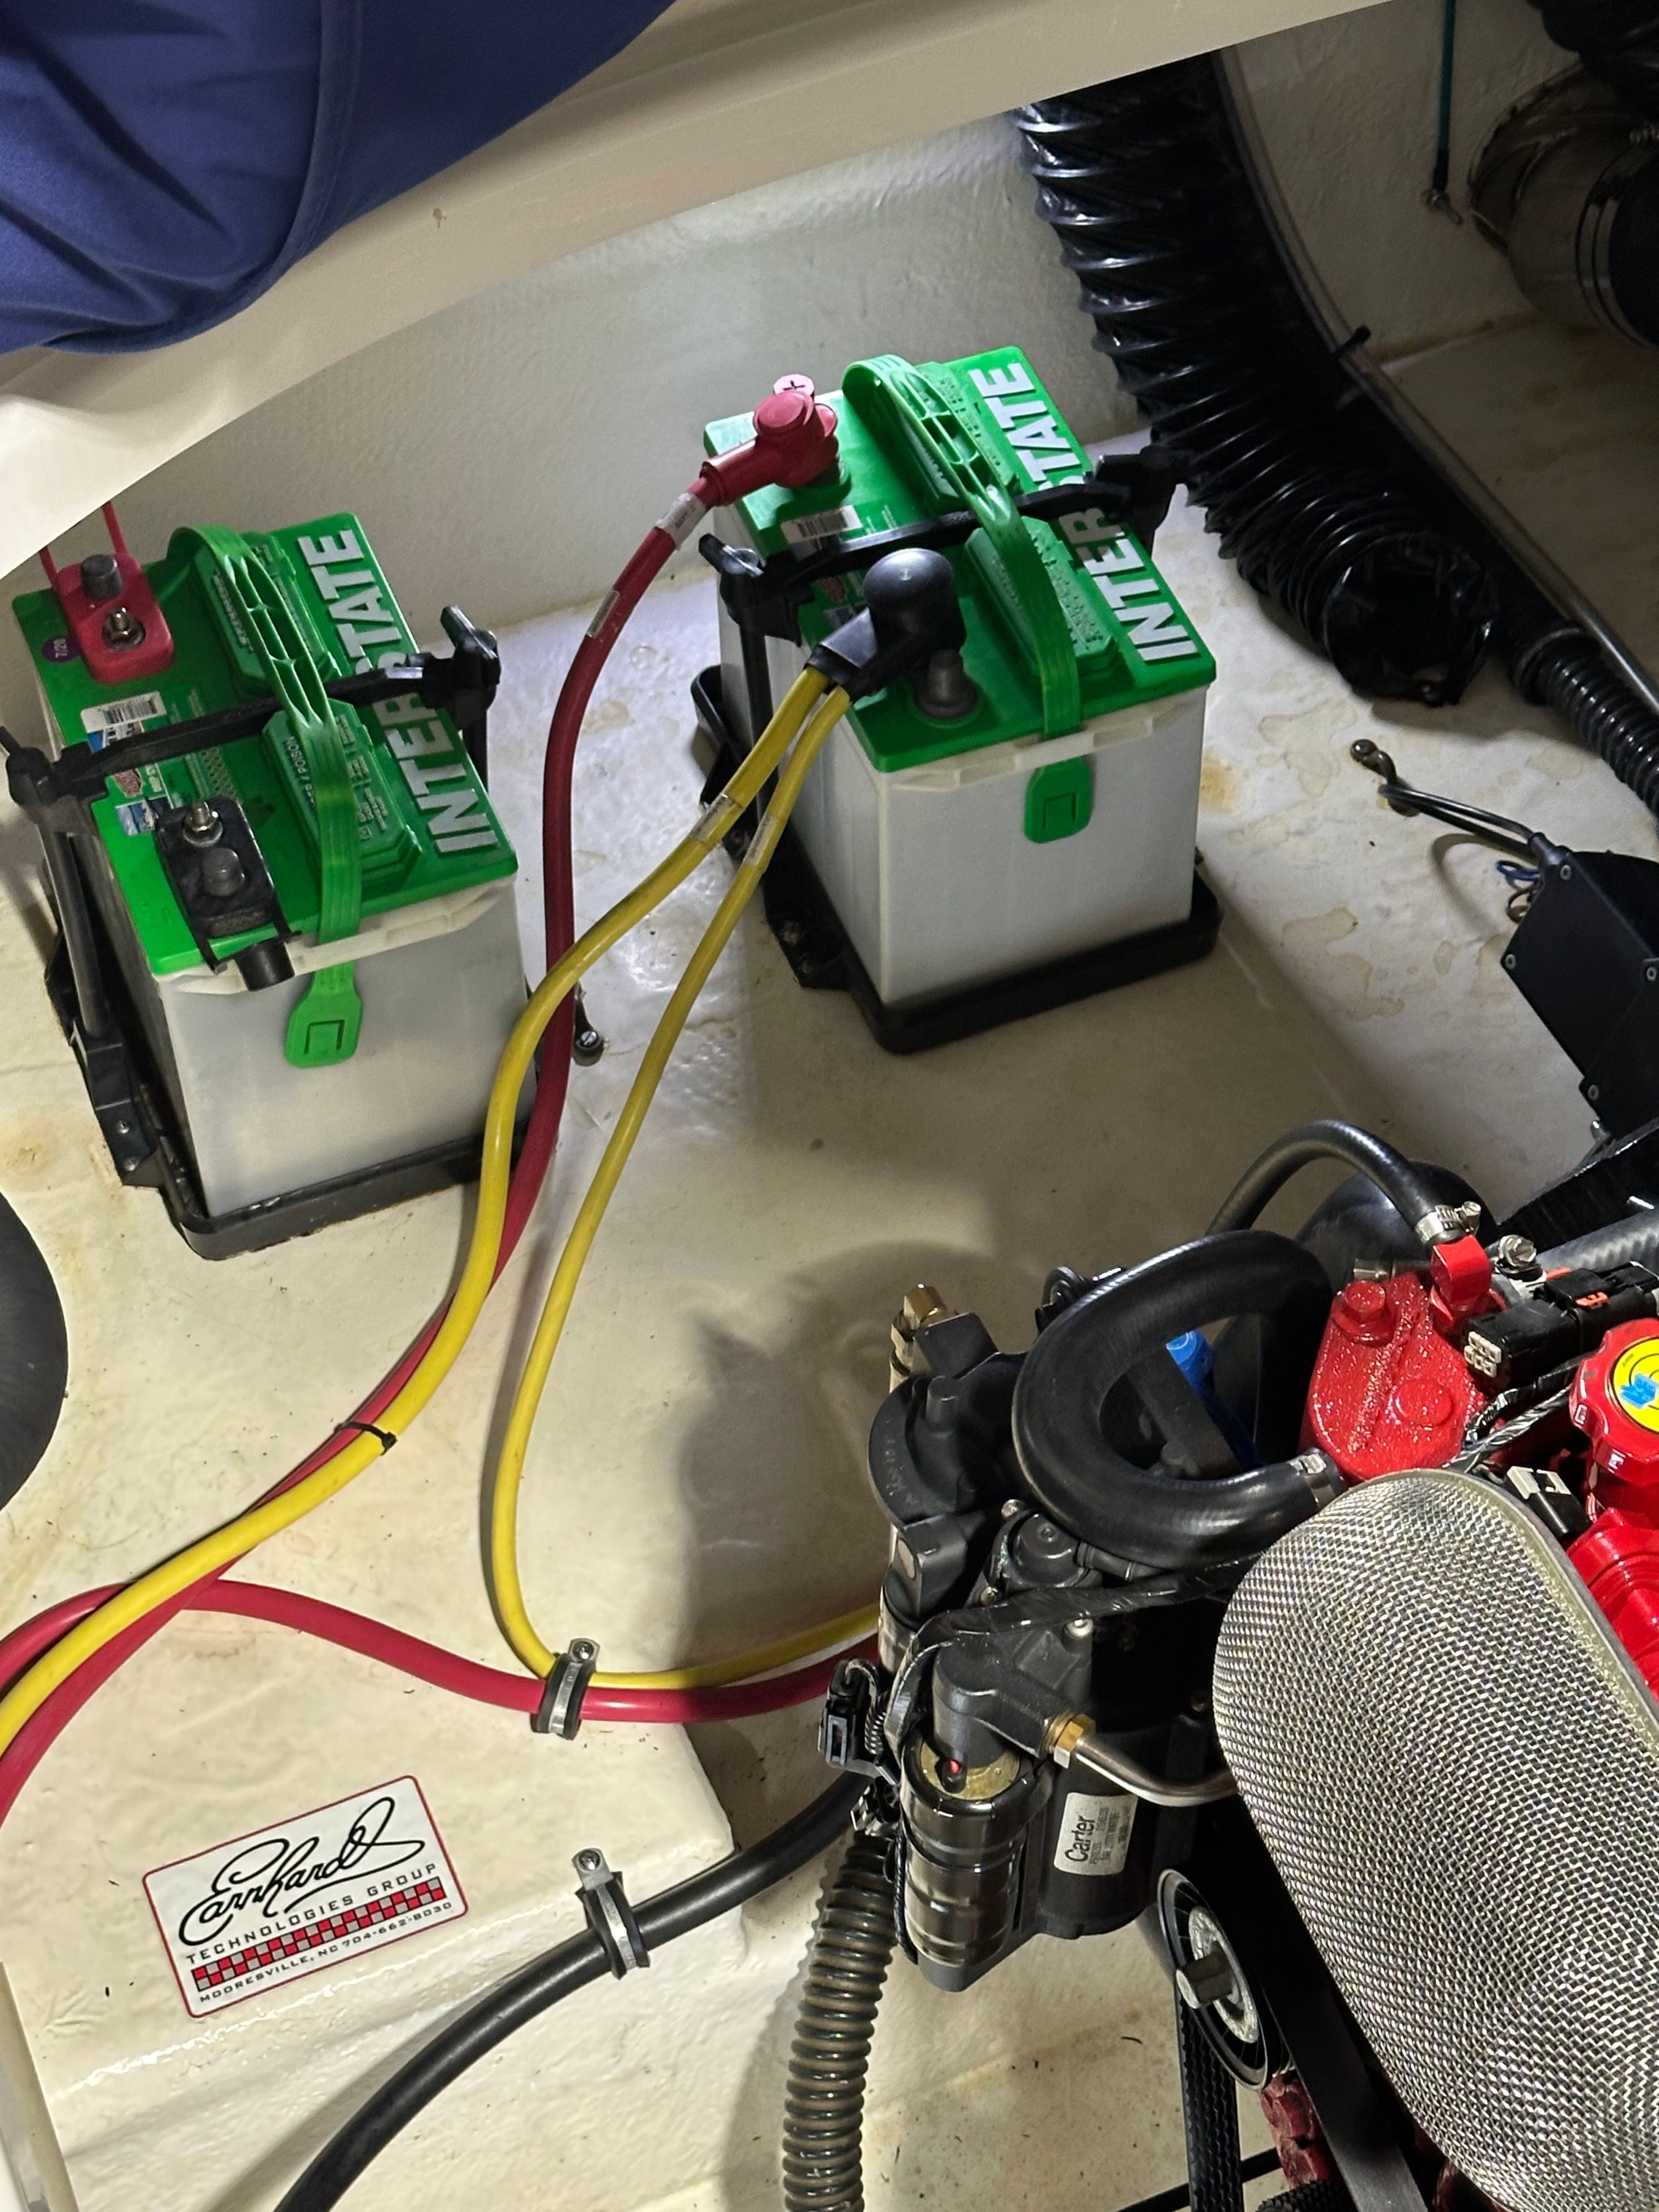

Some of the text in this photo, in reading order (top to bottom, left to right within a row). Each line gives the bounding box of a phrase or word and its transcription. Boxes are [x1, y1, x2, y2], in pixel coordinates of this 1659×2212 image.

[1064, 1815, 1096, 1863] Carter
[186, 1863, 437, 1965] TECHNOLOGIES GROUP
[200, 1901, 452, 2003] MOORESVILLE, NC 704-662-8030
